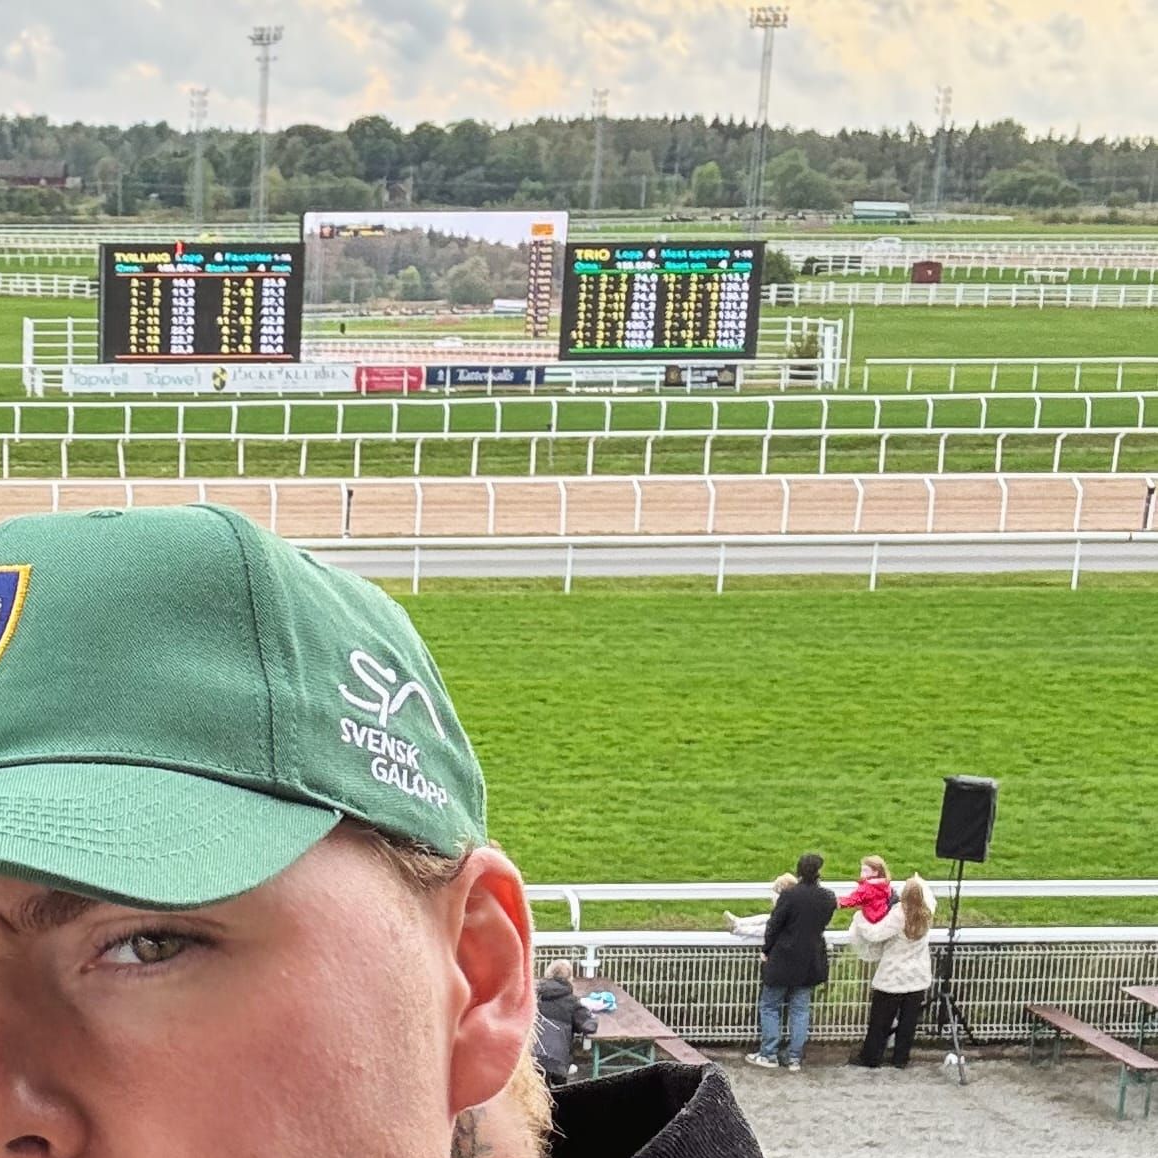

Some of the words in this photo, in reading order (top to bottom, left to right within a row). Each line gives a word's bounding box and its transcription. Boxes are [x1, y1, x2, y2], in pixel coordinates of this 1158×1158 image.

[114, 252, 171, 263] TVILLING
[574, 248, 610, 261] TRIO
[144, 371, 201, 386] Tapwel
[456, 368, 514, 381] Tatteralls
[340, 718, 421, 769] SVENSK
[371, 756, 449, 808] GALOPP
